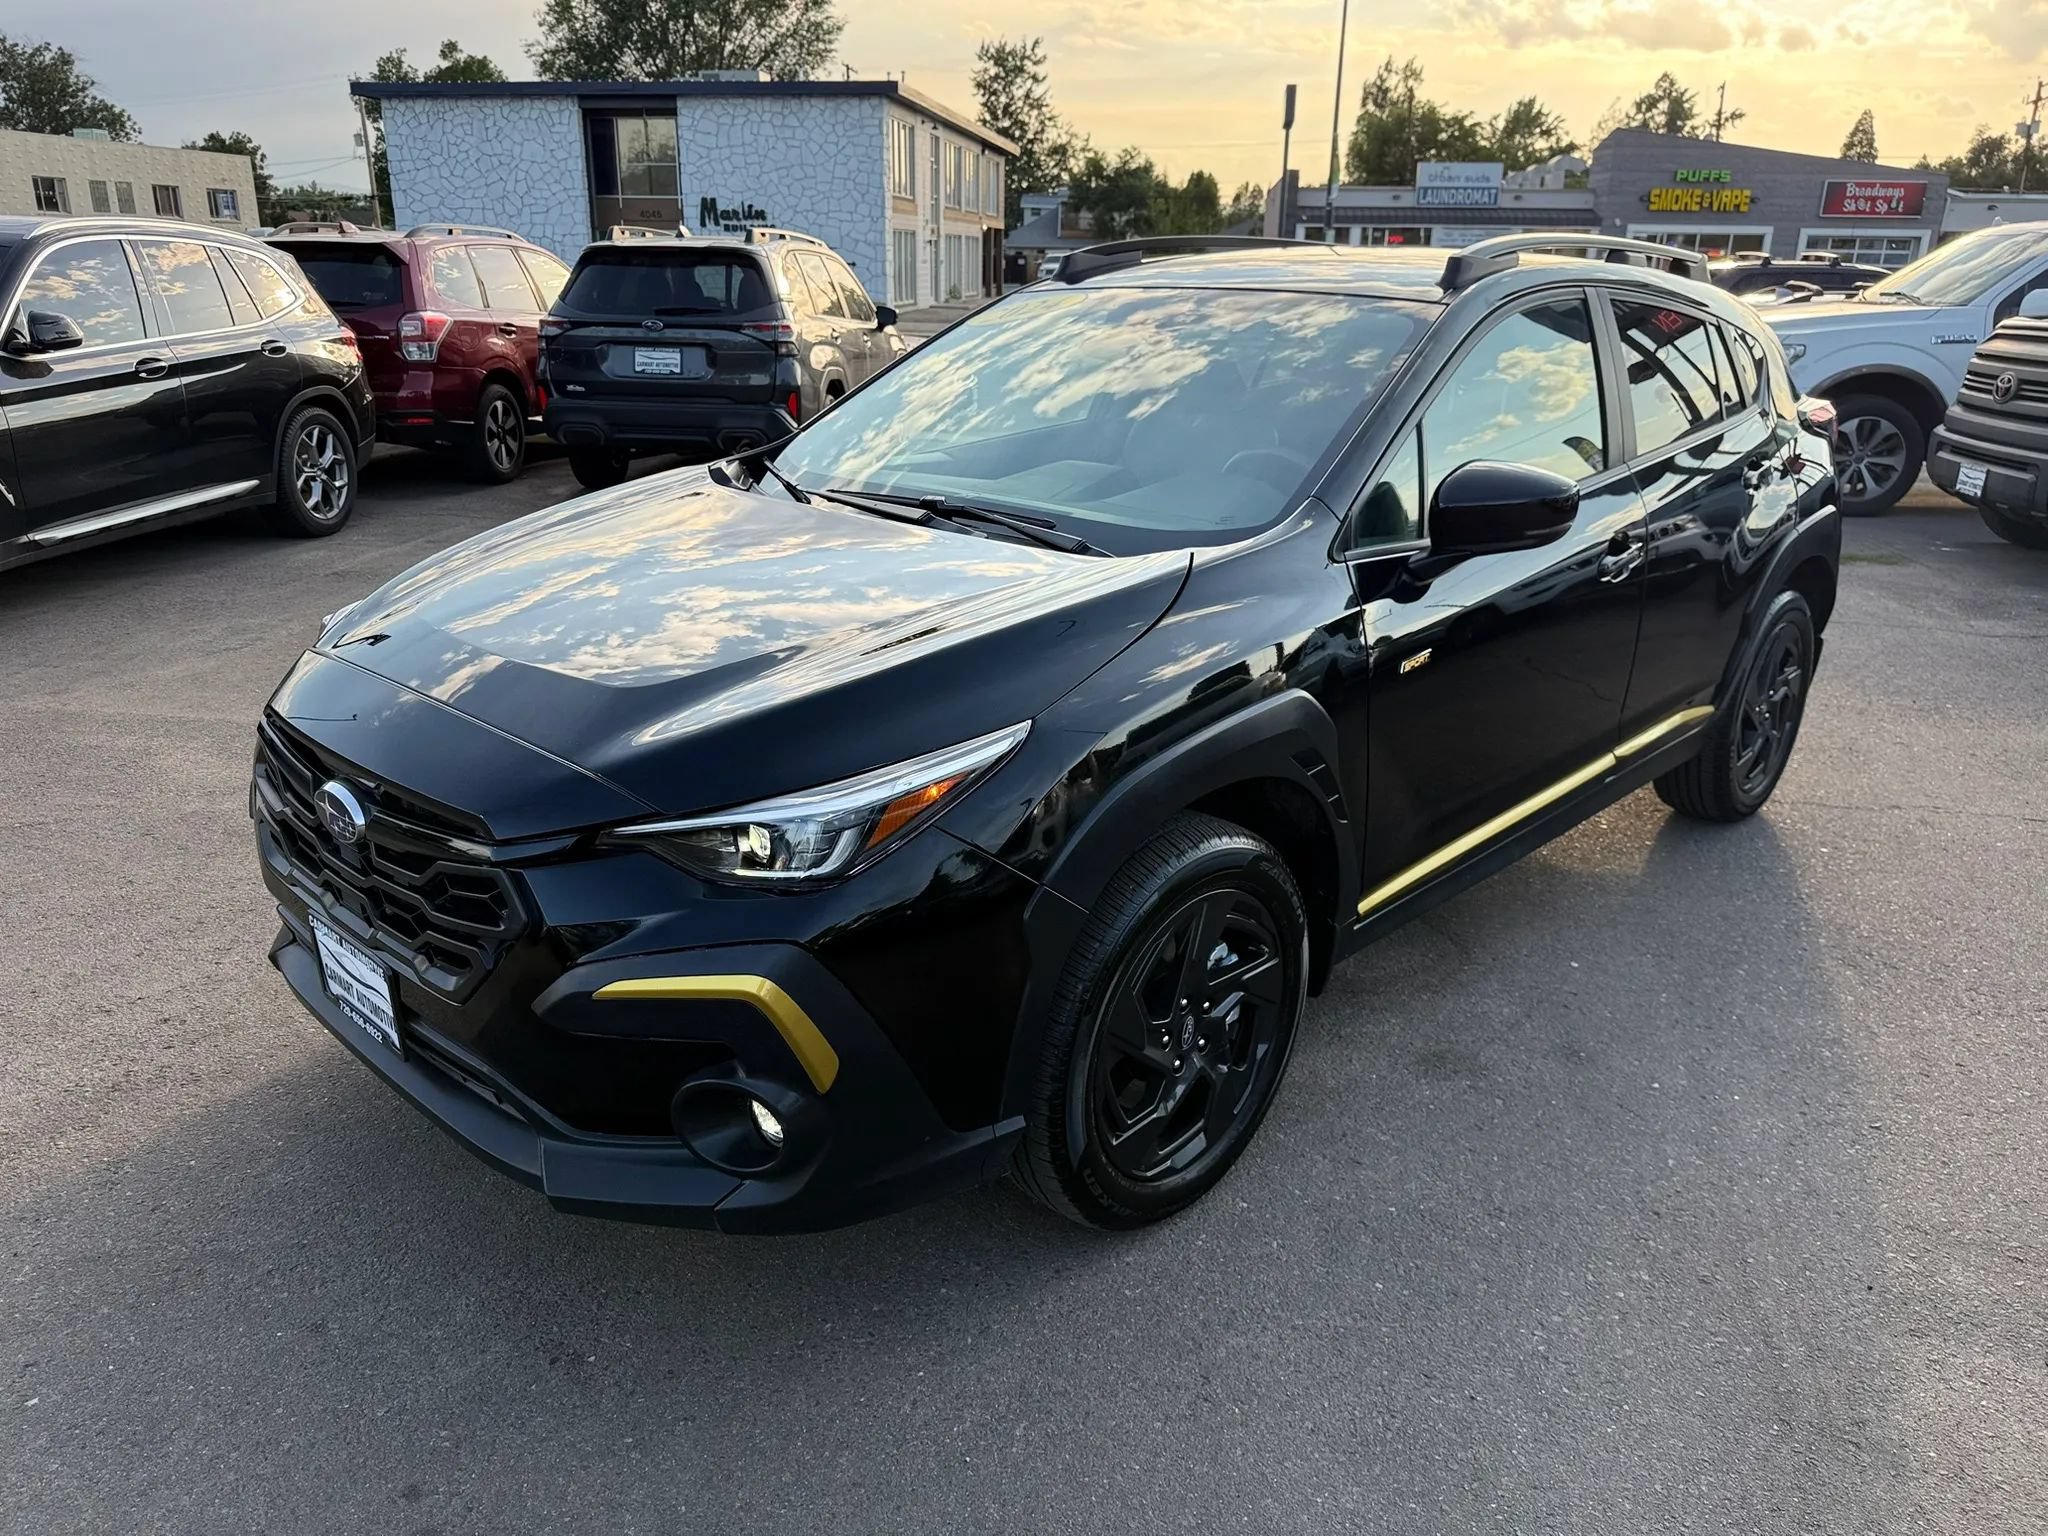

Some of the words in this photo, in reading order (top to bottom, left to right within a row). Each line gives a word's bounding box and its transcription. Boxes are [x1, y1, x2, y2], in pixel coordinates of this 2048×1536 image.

[1675, 169, 1732, 183] PUFFS
[1418, 188, 1498, 205] LAUNDROMAT
[1648, 188, 1703, 212] SMOKE
[1711, 188, 1752, 213] VAPE
[1845, 182, 1905, 200] Broadways
[700, 197, 767, 228] Marlin
[308, 914, 341, 947] CARMART
[325, 962, 355, 999] CARMART
